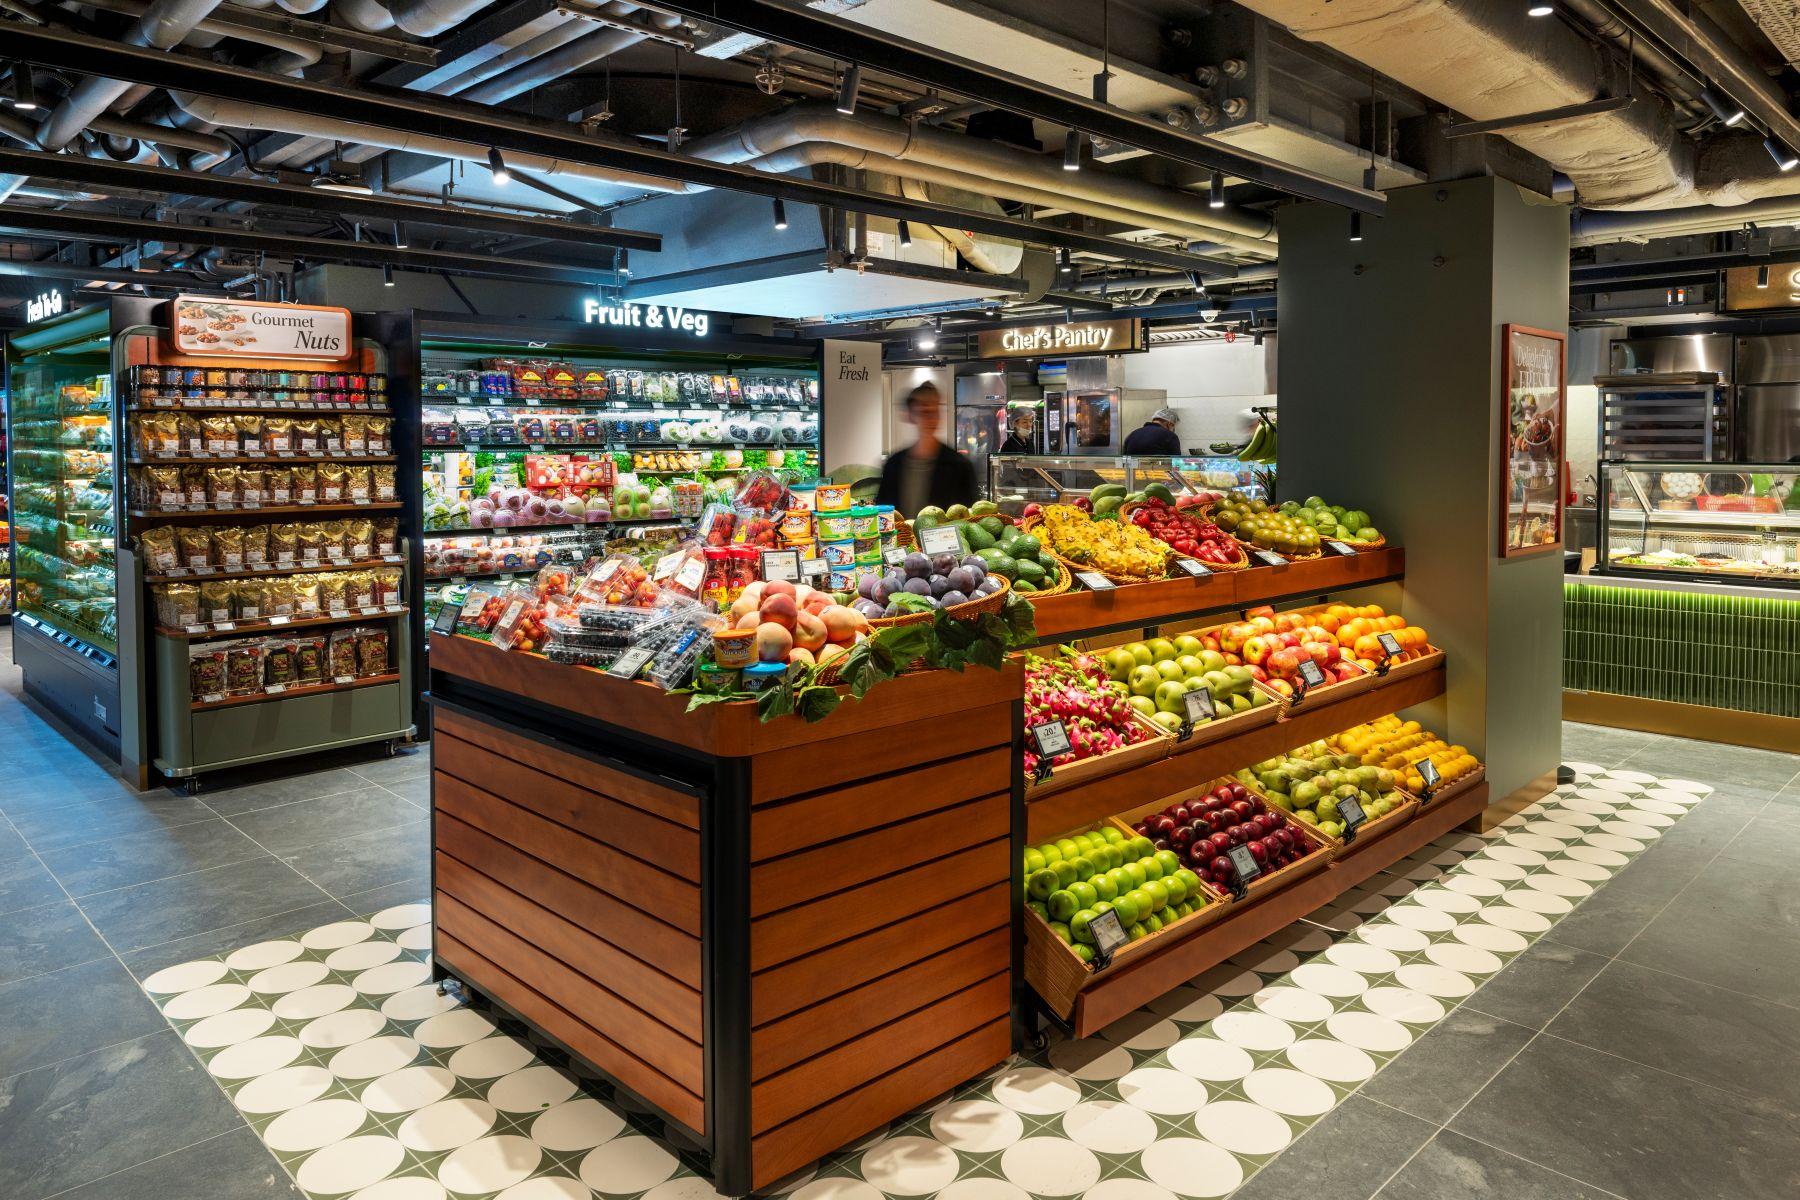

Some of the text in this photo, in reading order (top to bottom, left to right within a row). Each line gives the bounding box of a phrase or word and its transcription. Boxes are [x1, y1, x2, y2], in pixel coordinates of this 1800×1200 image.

[251, 311, 315, 328] Gourmet
[585, 300, 708, 337] Fruit & Veg
[293, 330, 340, 350] Nuts
[1002, 325, 1113, 351] Chef's Pantry
[839, 350, 857, 365] Eat
[837, 365, 869, 381] Fresh
